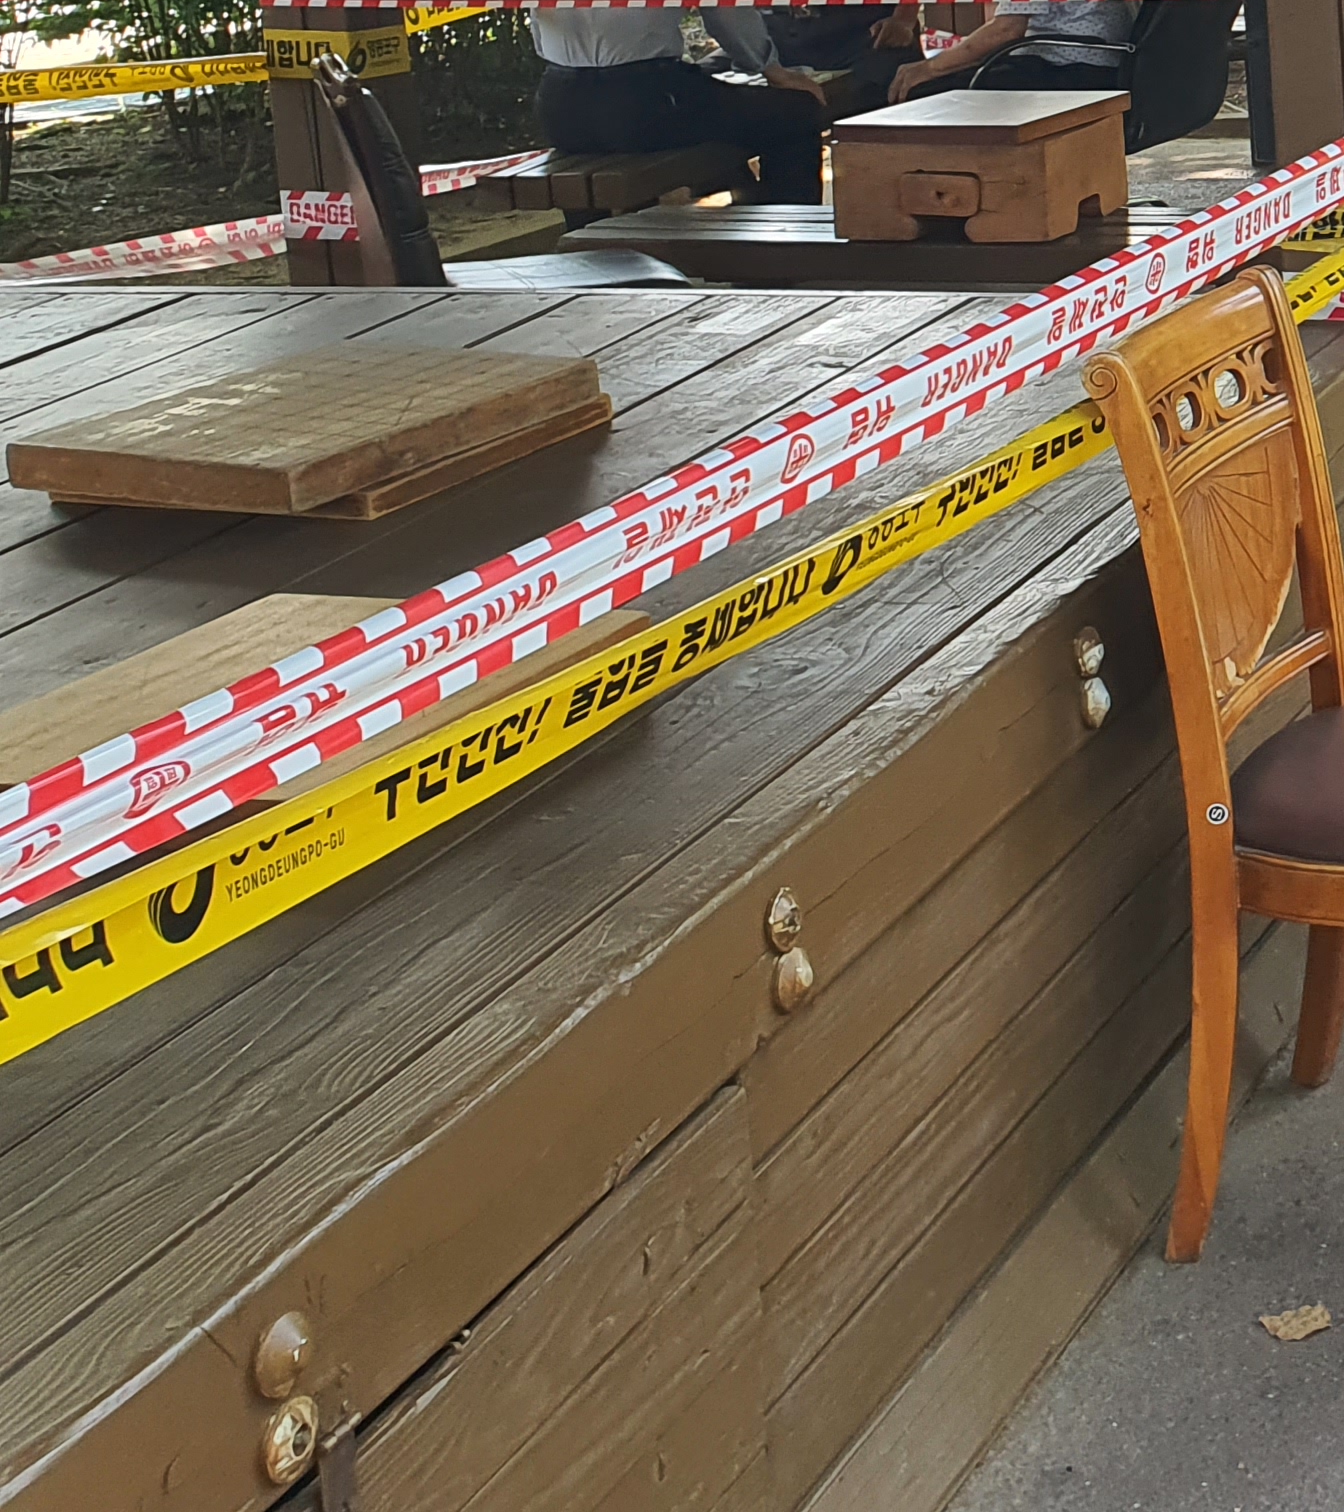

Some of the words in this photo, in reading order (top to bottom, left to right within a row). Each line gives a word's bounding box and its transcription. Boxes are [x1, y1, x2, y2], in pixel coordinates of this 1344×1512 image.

[1185, 228, 1216, 274] 위험
[1234, 191, 1293, 246] DANGER
[1046, 273, 1129, 345] 안전제일
[921, 333, 1012, 408] DANGER
[842, 394, 896, 452] 위험
[224, 828, 347, 904] YEONGDEUNGPO-GU
